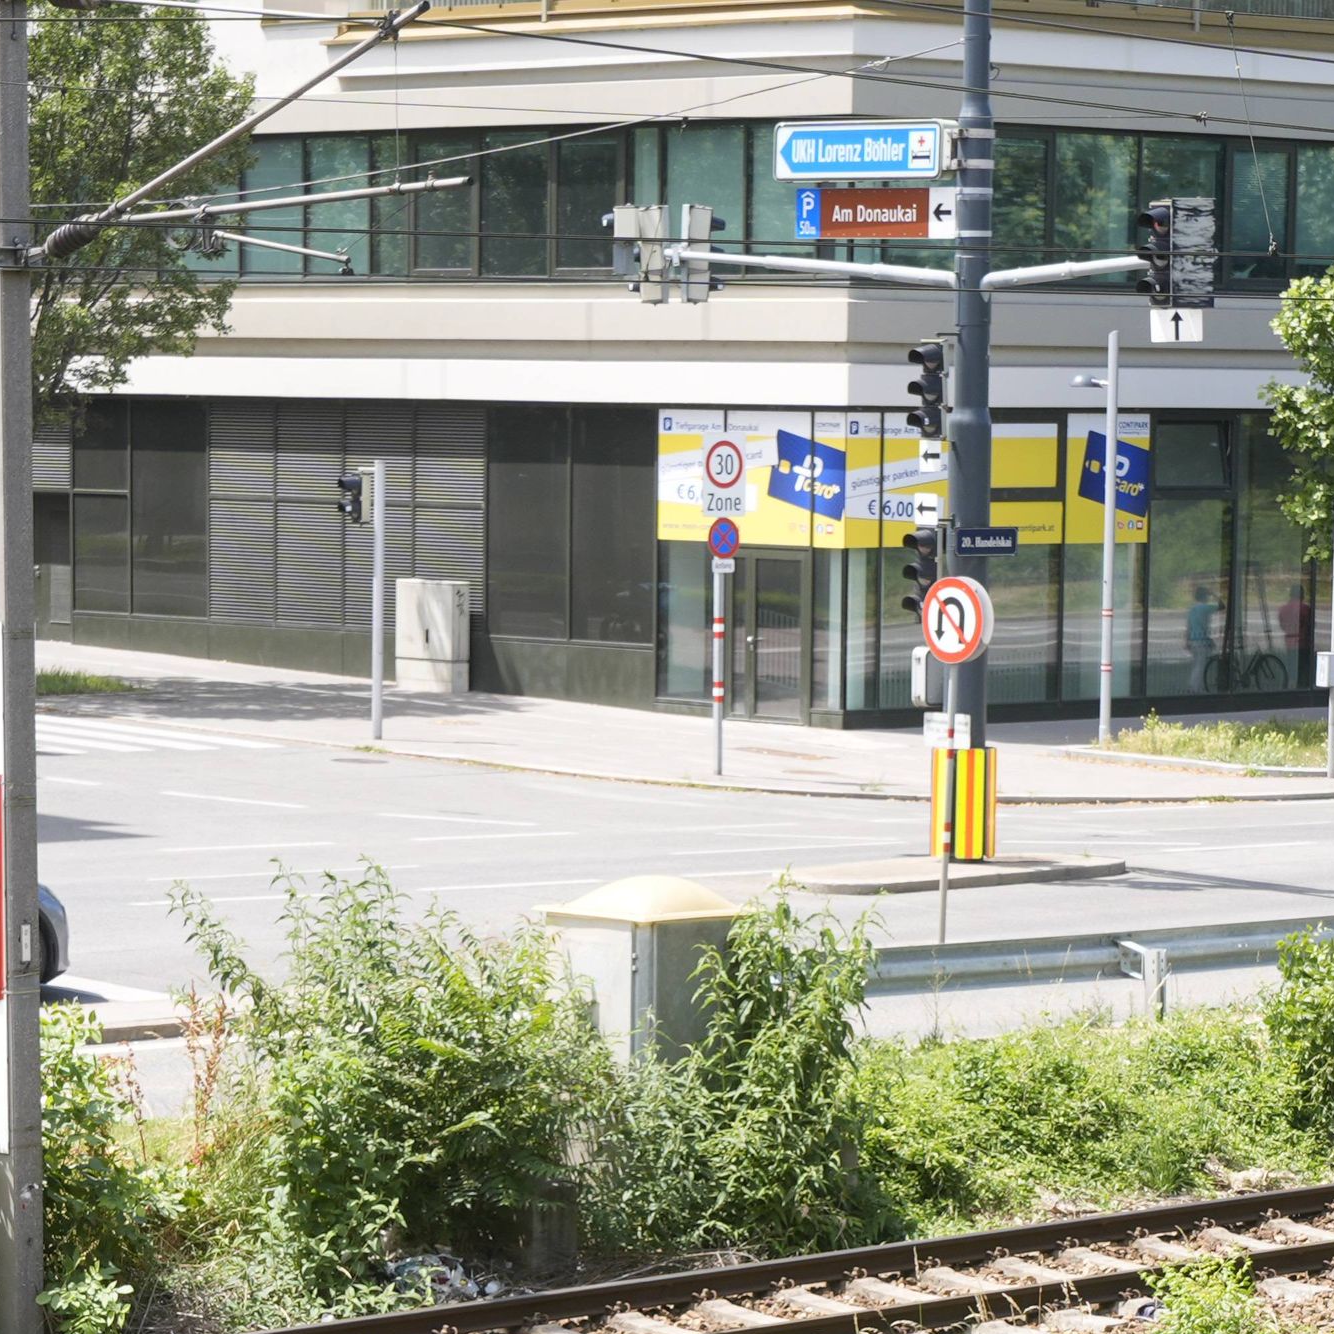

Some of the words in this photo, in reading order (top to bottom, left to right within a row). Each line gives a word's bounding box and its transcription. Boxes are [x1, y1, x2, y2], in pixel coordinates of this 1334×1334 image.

[792, 139, 815, 163] UKH
[818, 139, 861, 163] Lorenz
[864, 137, 905, 162] Böhler
[832, 205, 852, 222] Am
[857, 204, 917, 222] Donaukai
[799, 221, 816, 235] 50m
[715, 454, 733, 475] 30
[892, 469, 919, 483] parken
[707, 493, 741, 511] Zone
[868, 500, 876, 515] €
[883, 500, 914, 518] 6,00
[975, 536, 1012, 548] Handelskai
